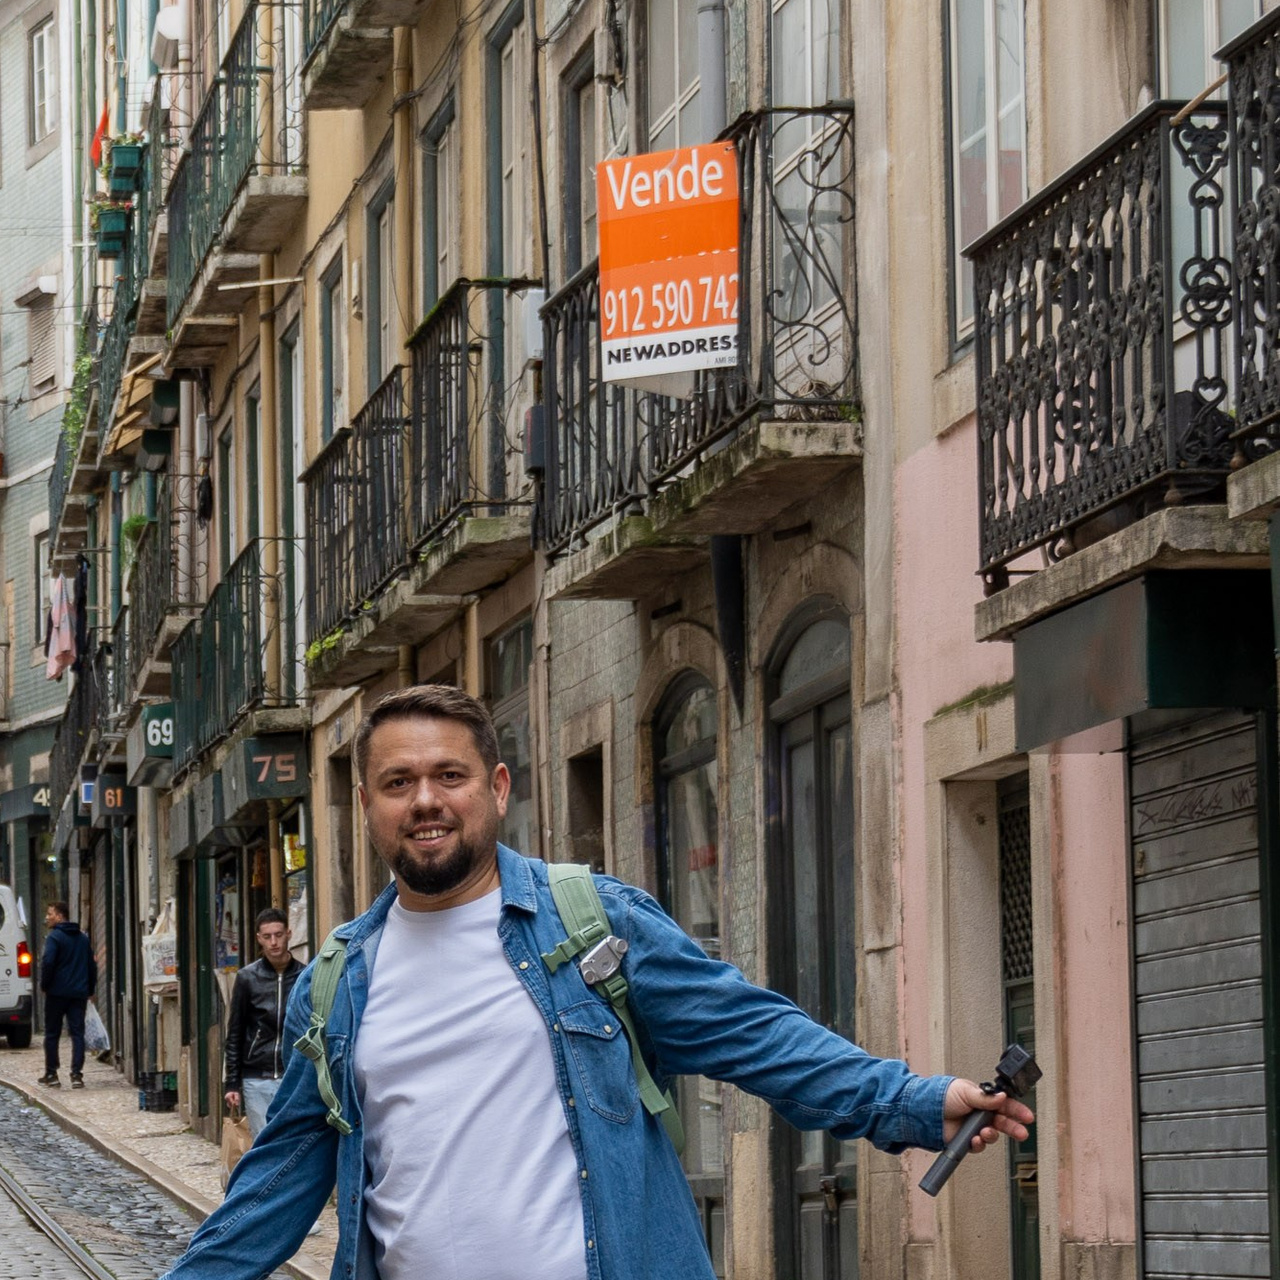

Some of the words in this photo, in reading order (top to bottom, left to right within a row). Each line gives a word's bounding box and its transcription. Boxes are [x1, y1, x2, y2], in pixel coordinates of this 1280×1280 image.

[606, 148, 723, 211] Vende
[604, 287, 645, 336] 912
[652, 279, 693, 329] 590
[607, 334, 740, 366] NEWADDRESS
[147, 719, 173, 746] 69
[252, 754, 297, 783] 75
[105, 787, 123, 808] 61
